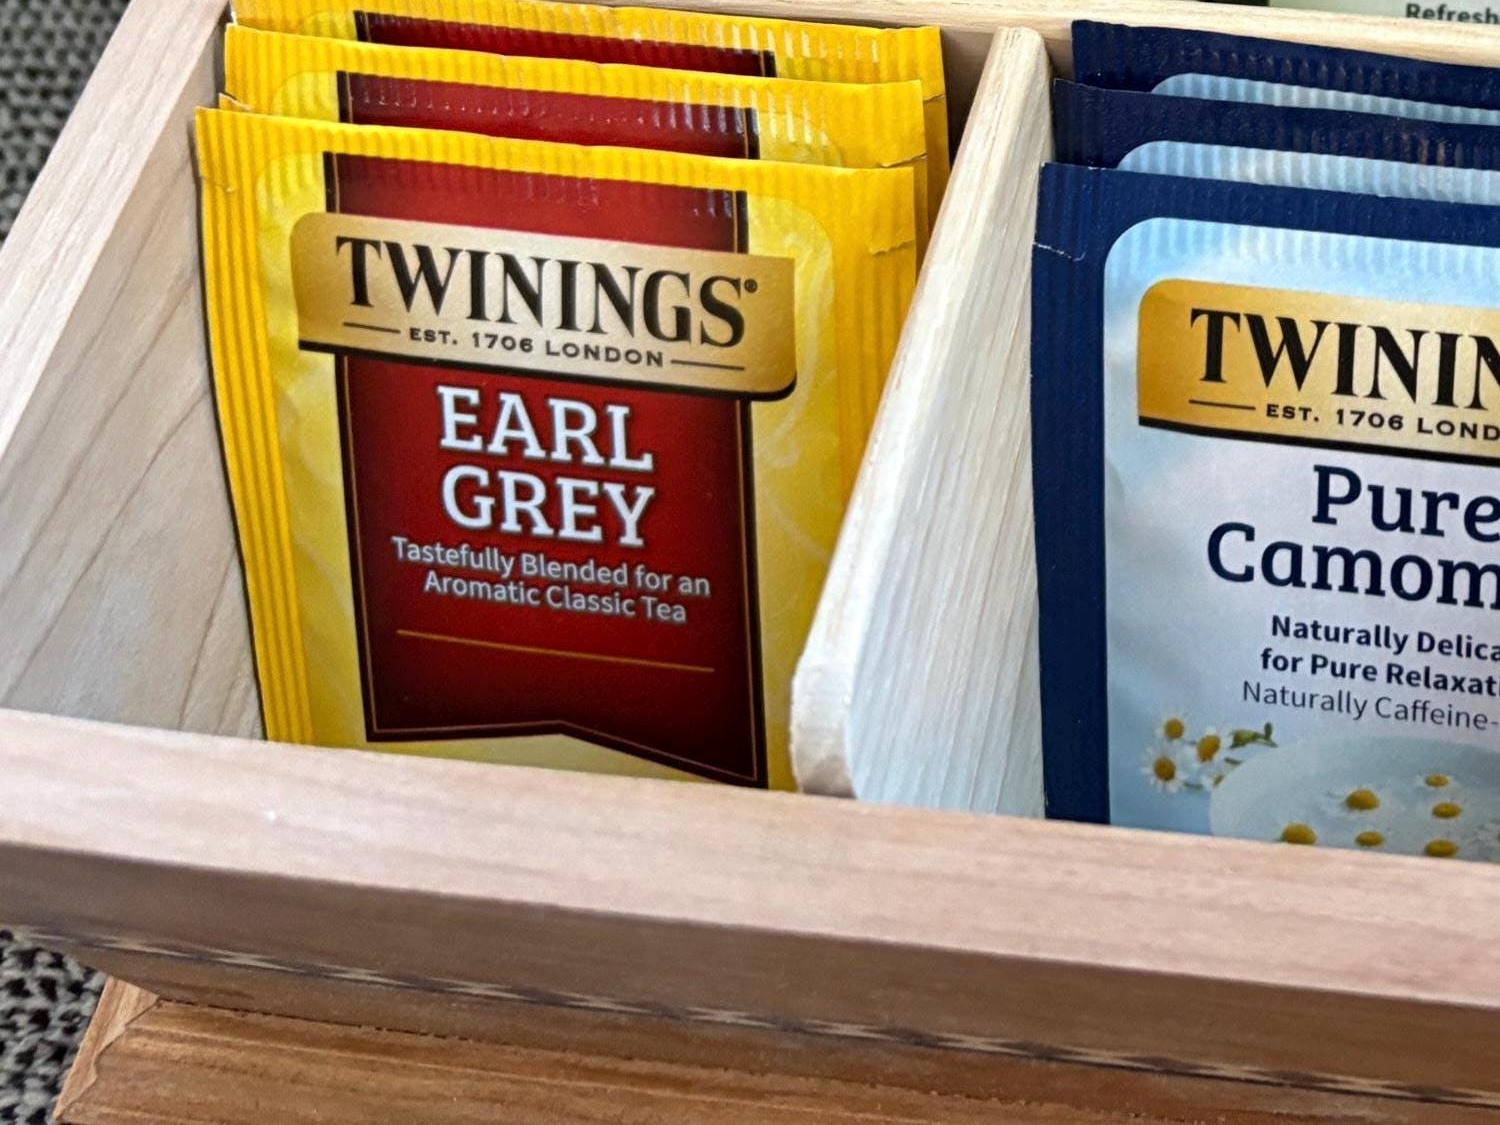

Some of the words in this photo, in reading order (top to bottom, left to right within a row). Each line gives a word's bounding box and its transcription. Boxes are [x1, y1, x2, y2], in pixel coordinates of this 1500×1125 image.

[408, 326, 459, 348] EST.
[472, 331, 535, 354] 1706
[545, 339, 664, 368] LONDON
[437, 384, 655, 472] EARL
[1265, 403, 1320, 423] EST.
[1334, 408, 1405, 433] 1706
[441, 465, 656, 548] GREY
[392, 537, 516, 578] Tastefully
[520, 552, 630, 588] Blended
[634, 563, 672, 591] for
[676, 574, 712, 598] an
[424, 571, 542, 607] Aromatic
[546, 584, 637, 619] Classic
[640, 595, 688, 625] Tea
[1270, 614, 1411, 656] Naturally
[1260, 647, 1305, 674] for
[1310, 652, 1380, 684] Pure
[1242, 679, 1370, 719] Naturally
